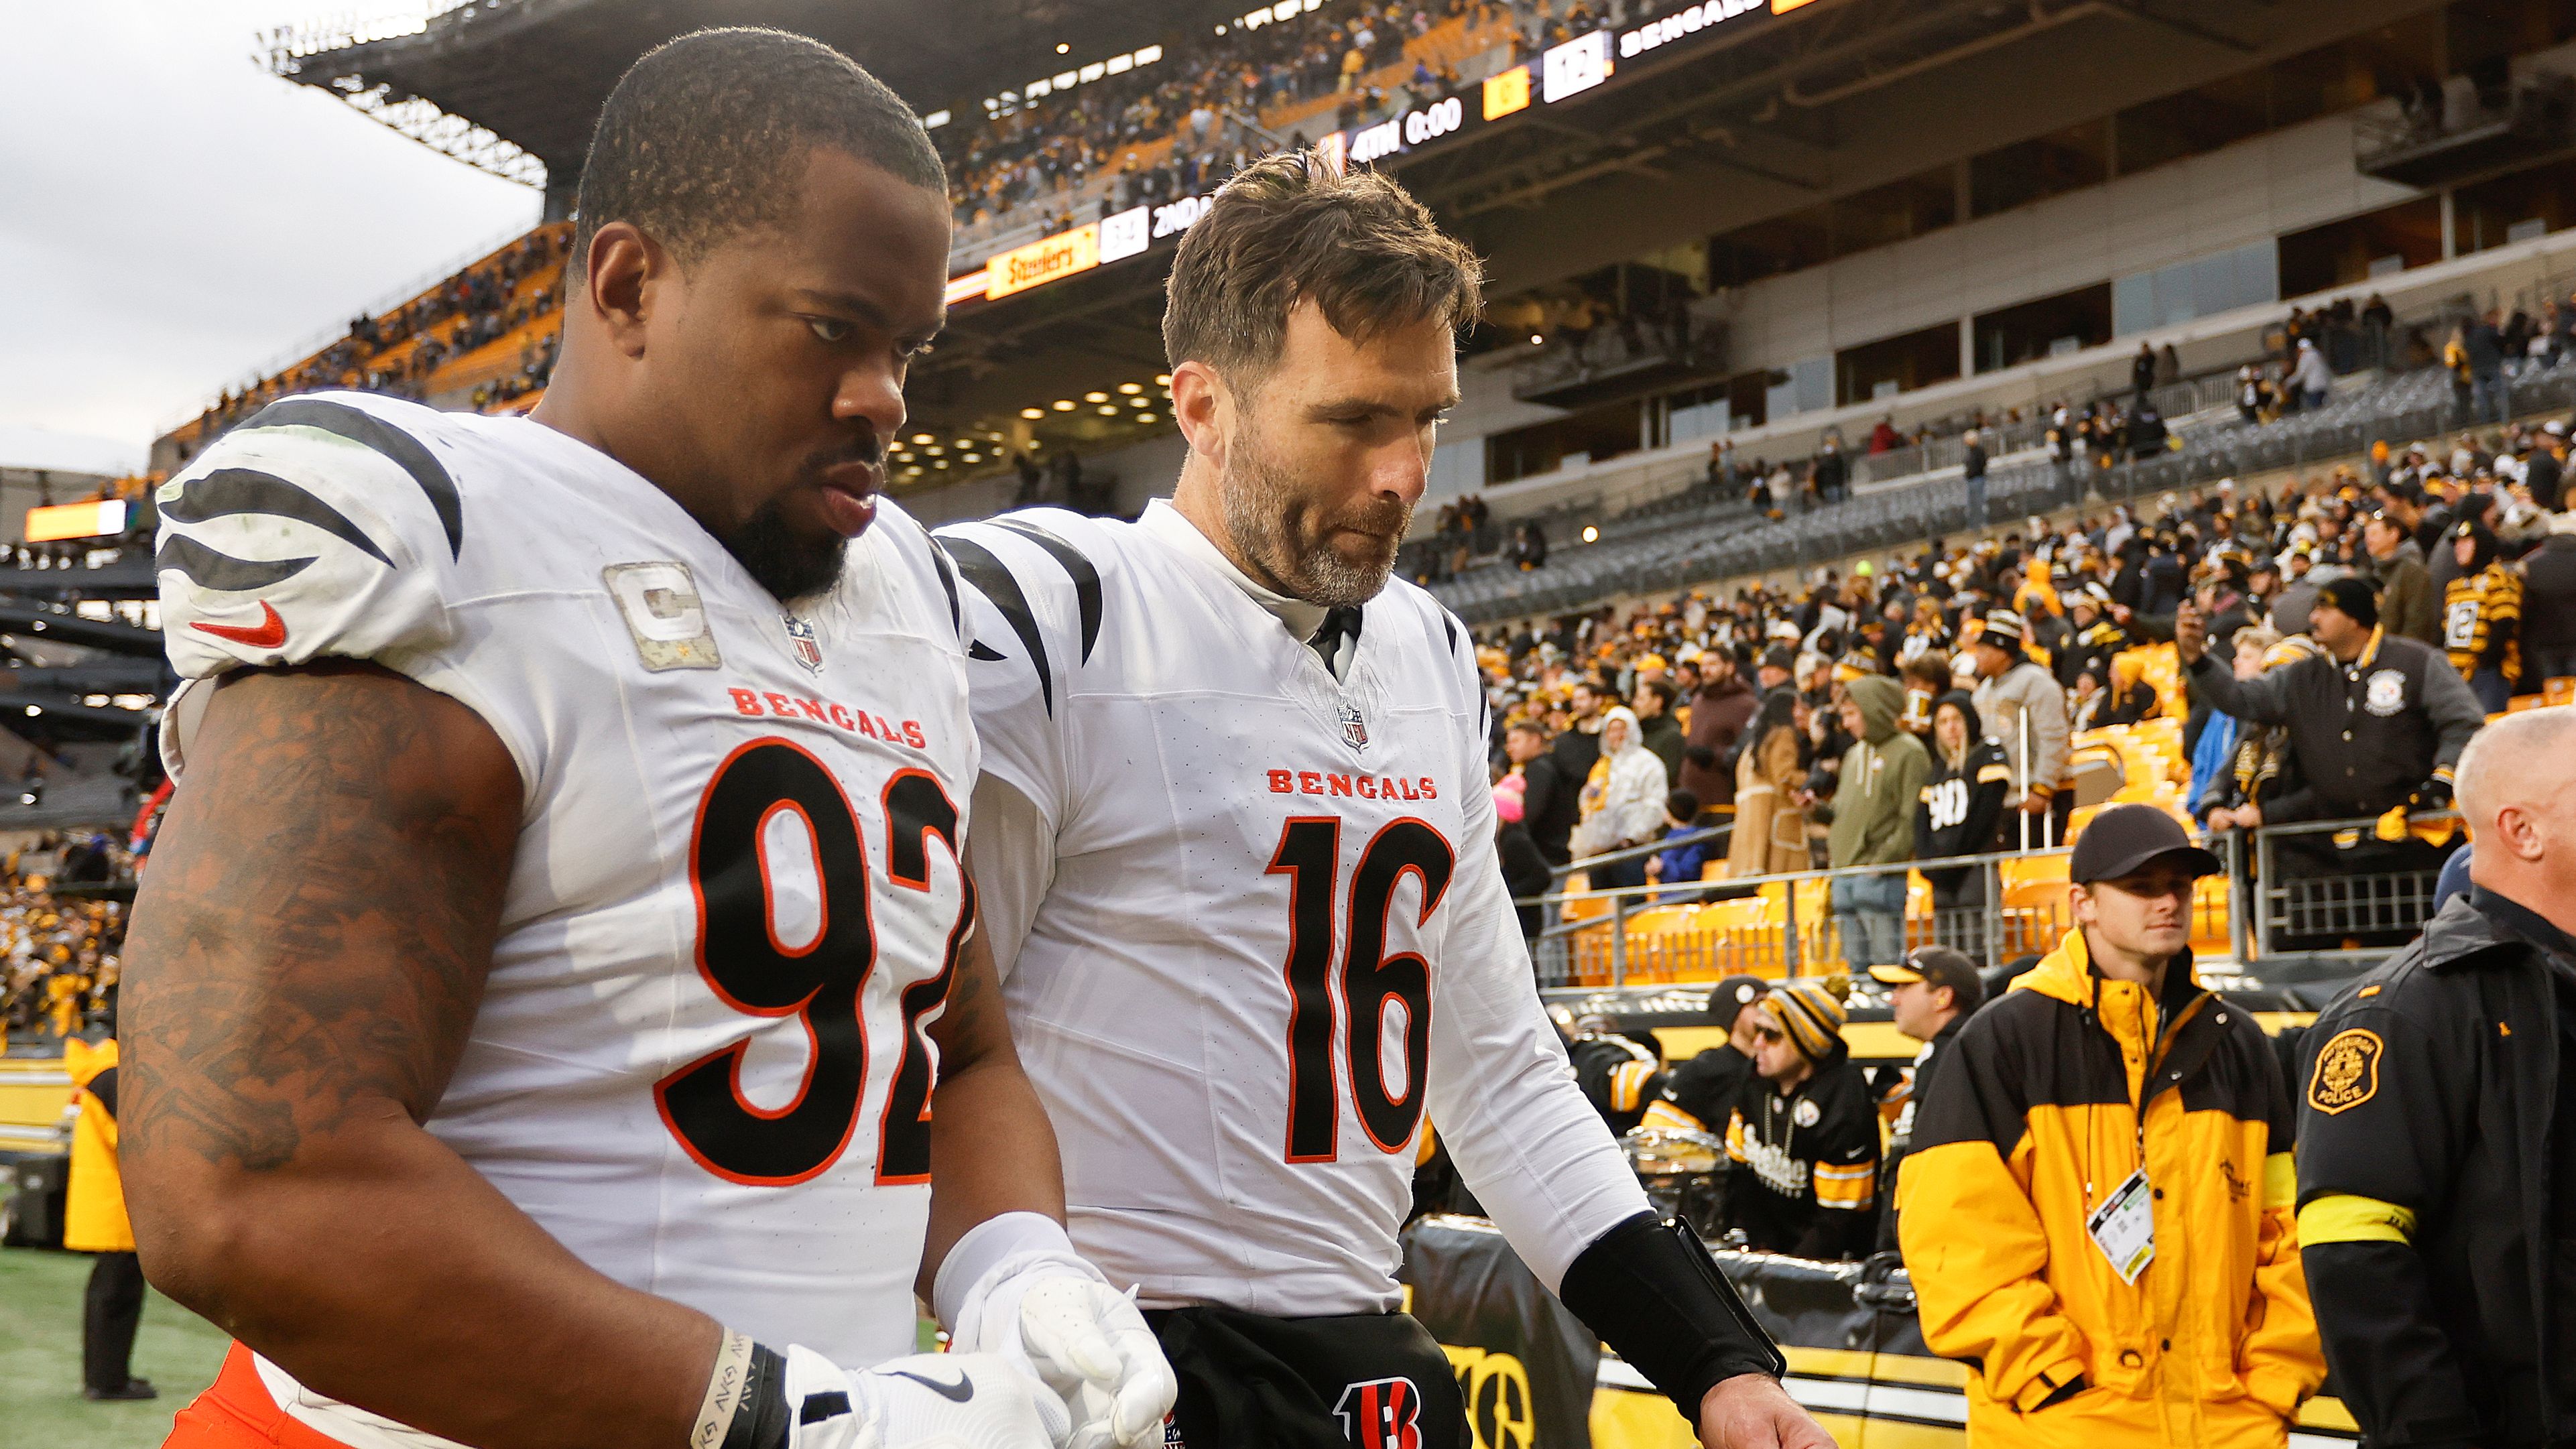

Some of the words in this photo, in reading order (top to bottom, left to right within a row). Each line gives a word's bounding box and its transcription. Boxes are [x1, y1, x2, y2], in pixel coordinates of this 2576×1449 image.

[1351, 120, 1401, 163] 4TH
[1406, 97, 1463, 145] 0:00
[615, 565, 705, 641] C
[727, 688, 926, 749] BENGALS
[1342, 722, 1367, 746] NFL
[1266, 769, 1438, 800] BENGALS
[653, 737, 976, 1186] 92
[1264, 816, 1455, 1163] 16
[2317, 1086, 2364, 1104] POLICE
